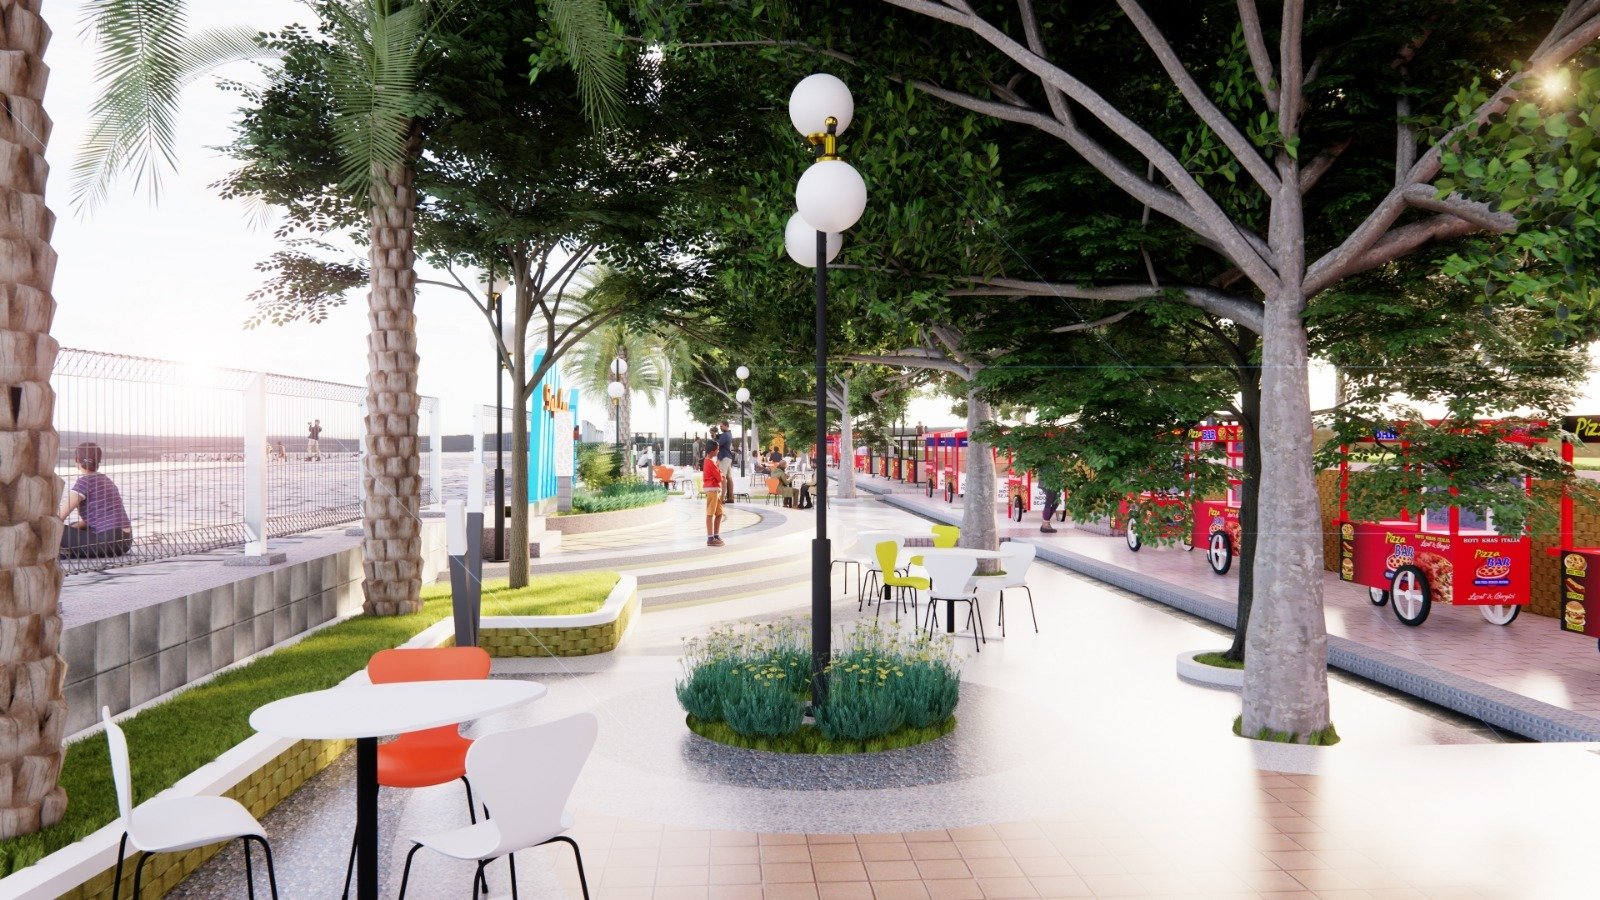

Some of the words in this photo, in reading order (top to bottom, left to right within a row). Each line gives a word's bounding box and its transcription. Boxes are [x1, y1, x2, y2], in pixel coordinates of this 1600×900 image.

[1575, 417, 1600, 437] Piz
[1385, 532, 1406, 544] Pizza
[1395, 544, 1414, 557] BAR
[1474, 549, 1500, 559] Pizza
[1487, 557, 1511, 567] BAR
